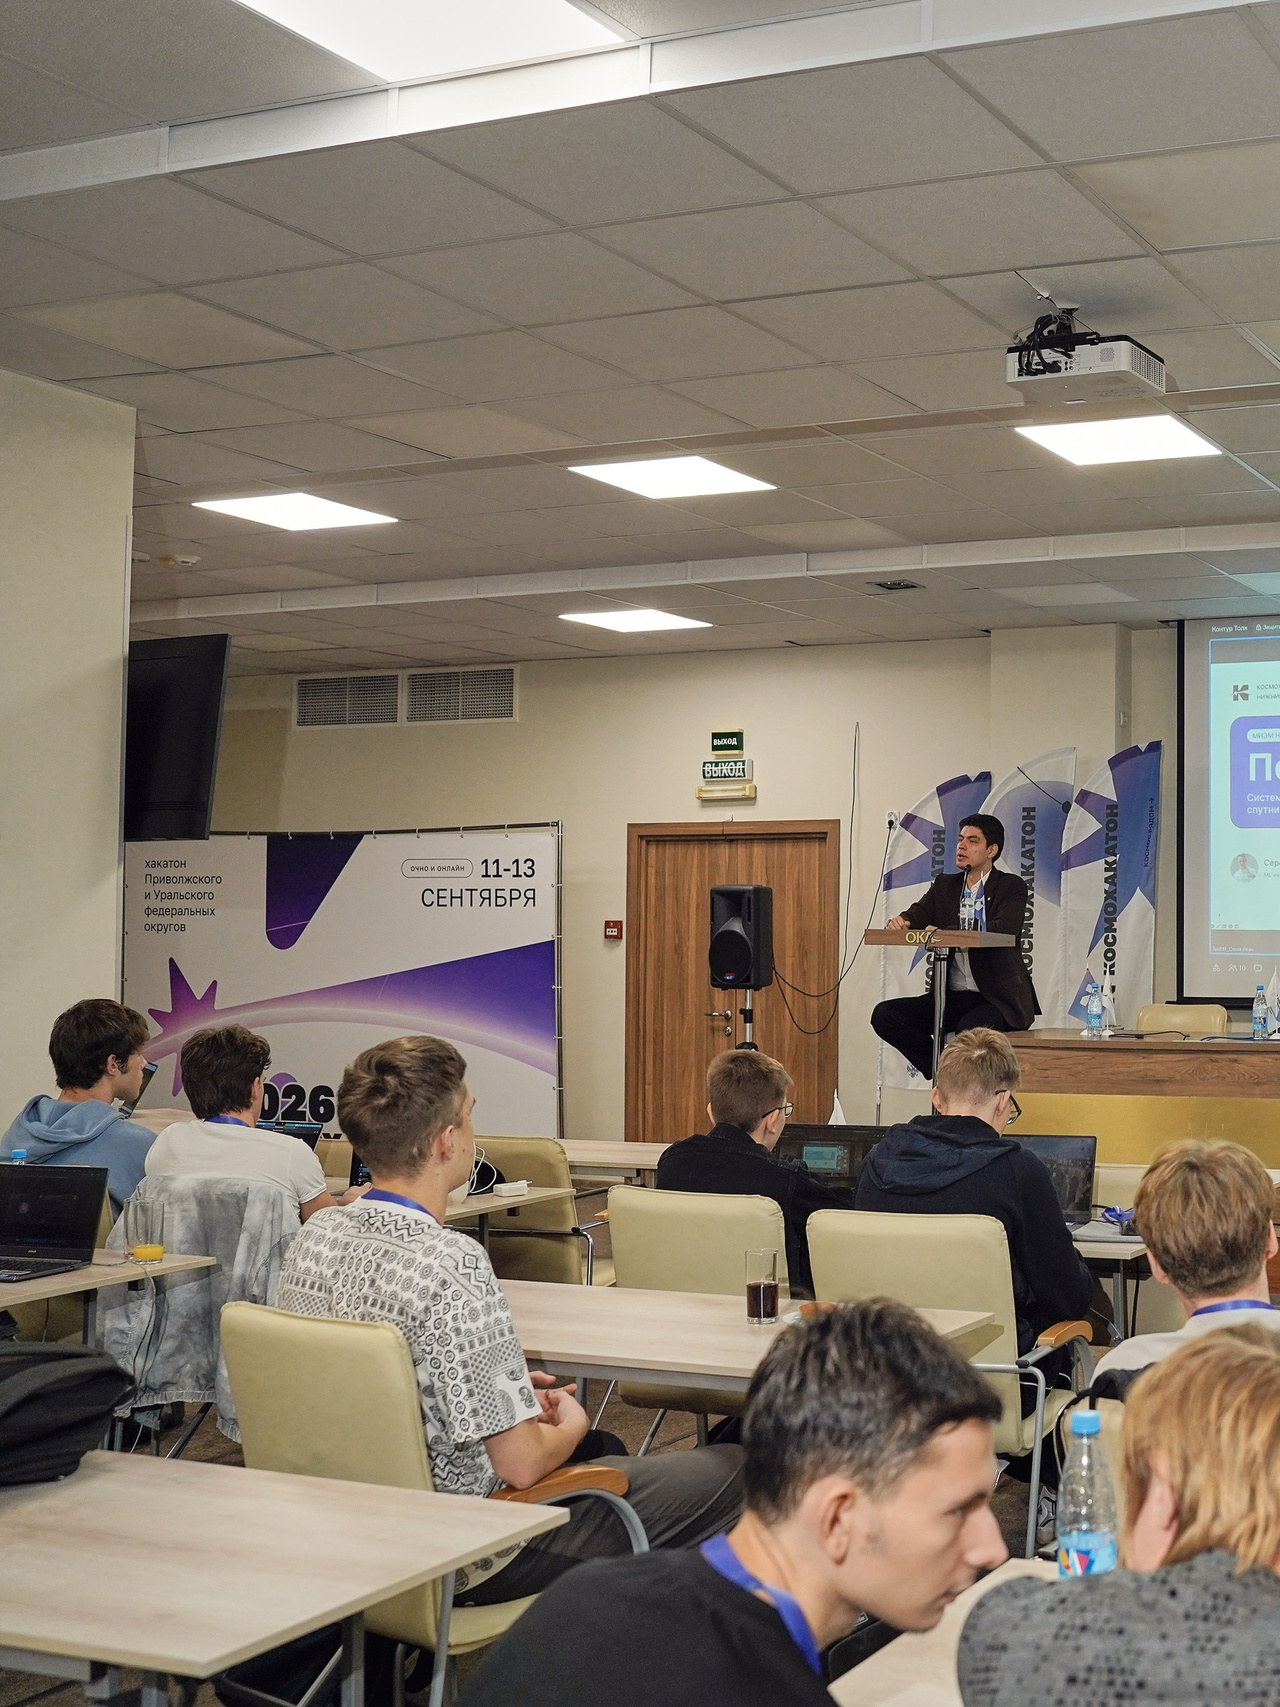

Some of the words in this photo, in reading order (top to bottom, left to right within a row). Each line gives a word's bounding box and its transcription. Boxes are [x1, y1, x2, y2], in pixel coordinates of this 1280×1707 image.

[1212, 625, 1233, 633] Контур
[1252, 731, 1273, 739] МИЭМ
[713, 737, 737, 746] ВЫХОД
[704, 762, 744, 778] ВЫХОД
[1143, 834, 1152, 868] КОСМОС
[145, 860, 187, 869] хакатон
[437, 864, 465, 872] ОНЛАЙН
[481, 858, 536, 878] 11-13
[144, 874, 222, 886] Приволжского
[1103, 803, 1119, 975] КОСМОХАКАТОН
[144, 892, 151, 900] и
[153, 890, 215, 902] Уральского
[421, 888, 536, 907] СЕНТЯБРЯ
[144, 905, 216, 918] федеральных
[144, 923, 186, 934] округов
[259, 1083, 335, 1124] 026
